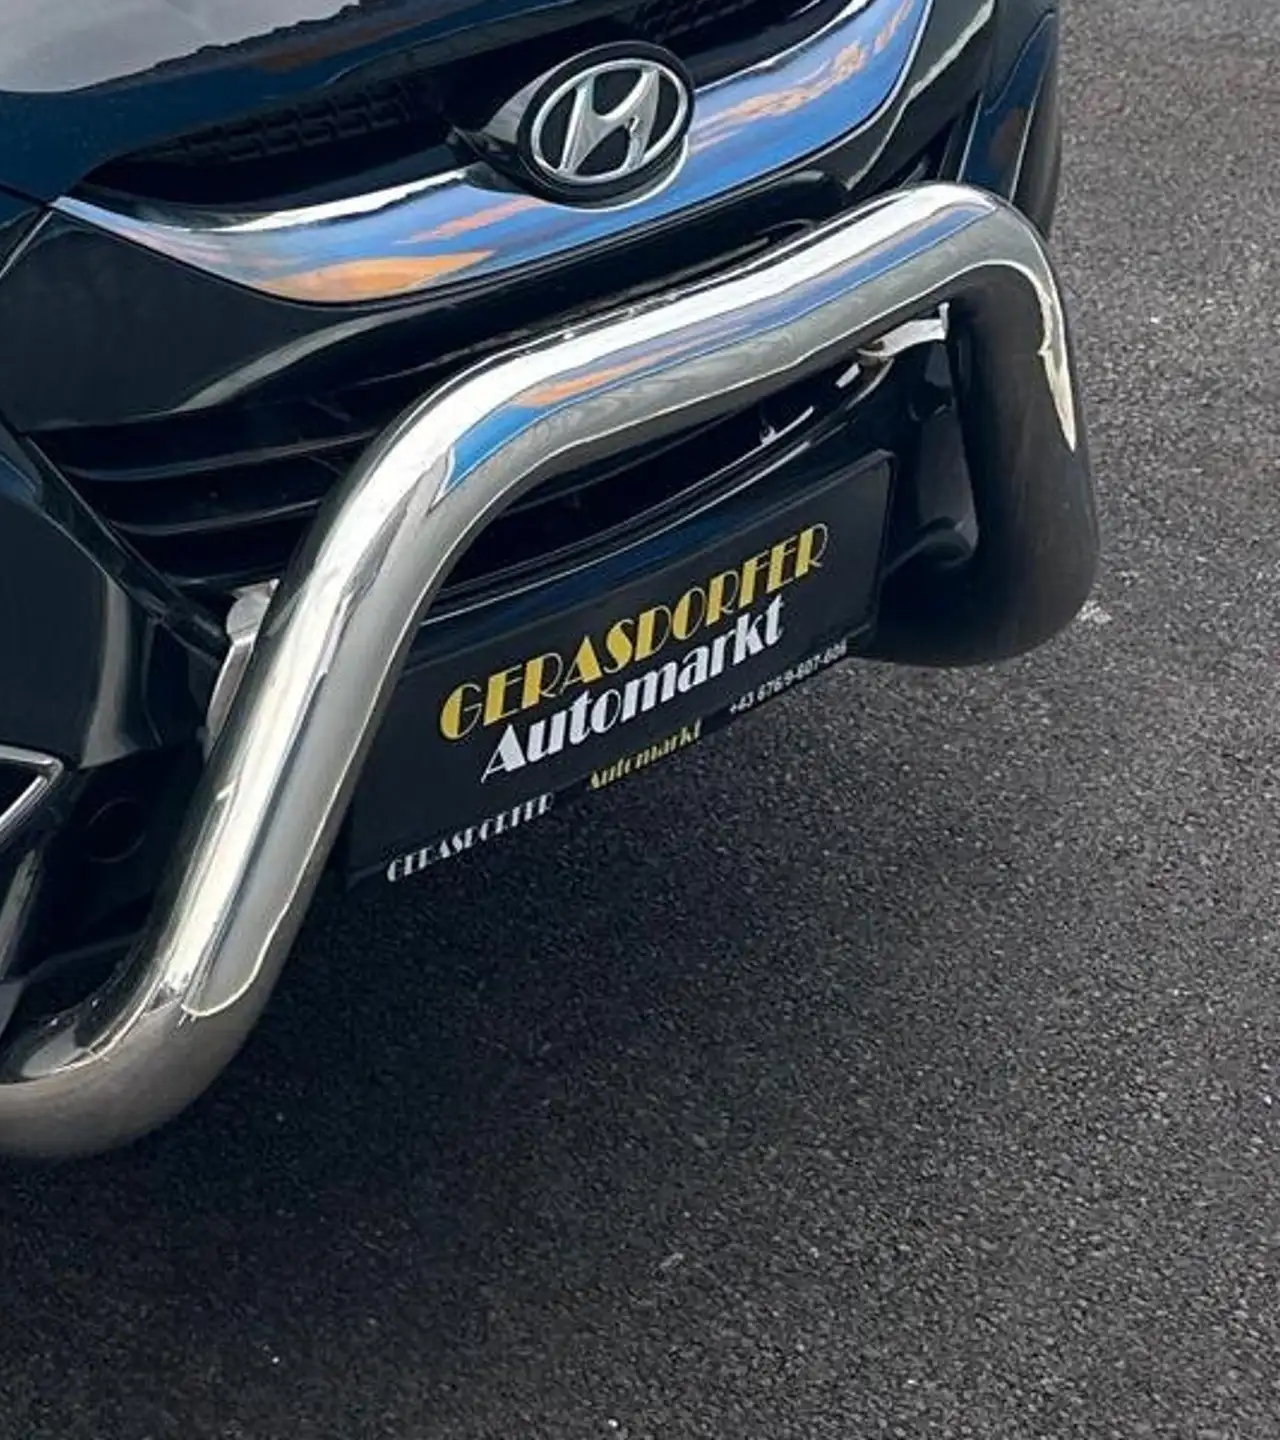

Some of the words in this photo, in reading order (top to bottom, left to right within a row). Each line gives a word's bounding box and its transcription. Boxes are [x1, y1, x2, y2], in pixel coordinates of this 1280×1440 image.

[440, 522, 830, 742] GERASDORFER
[480, 593, 786, 785] Automarkt
[588, 720, 703, 791] Automarkt
